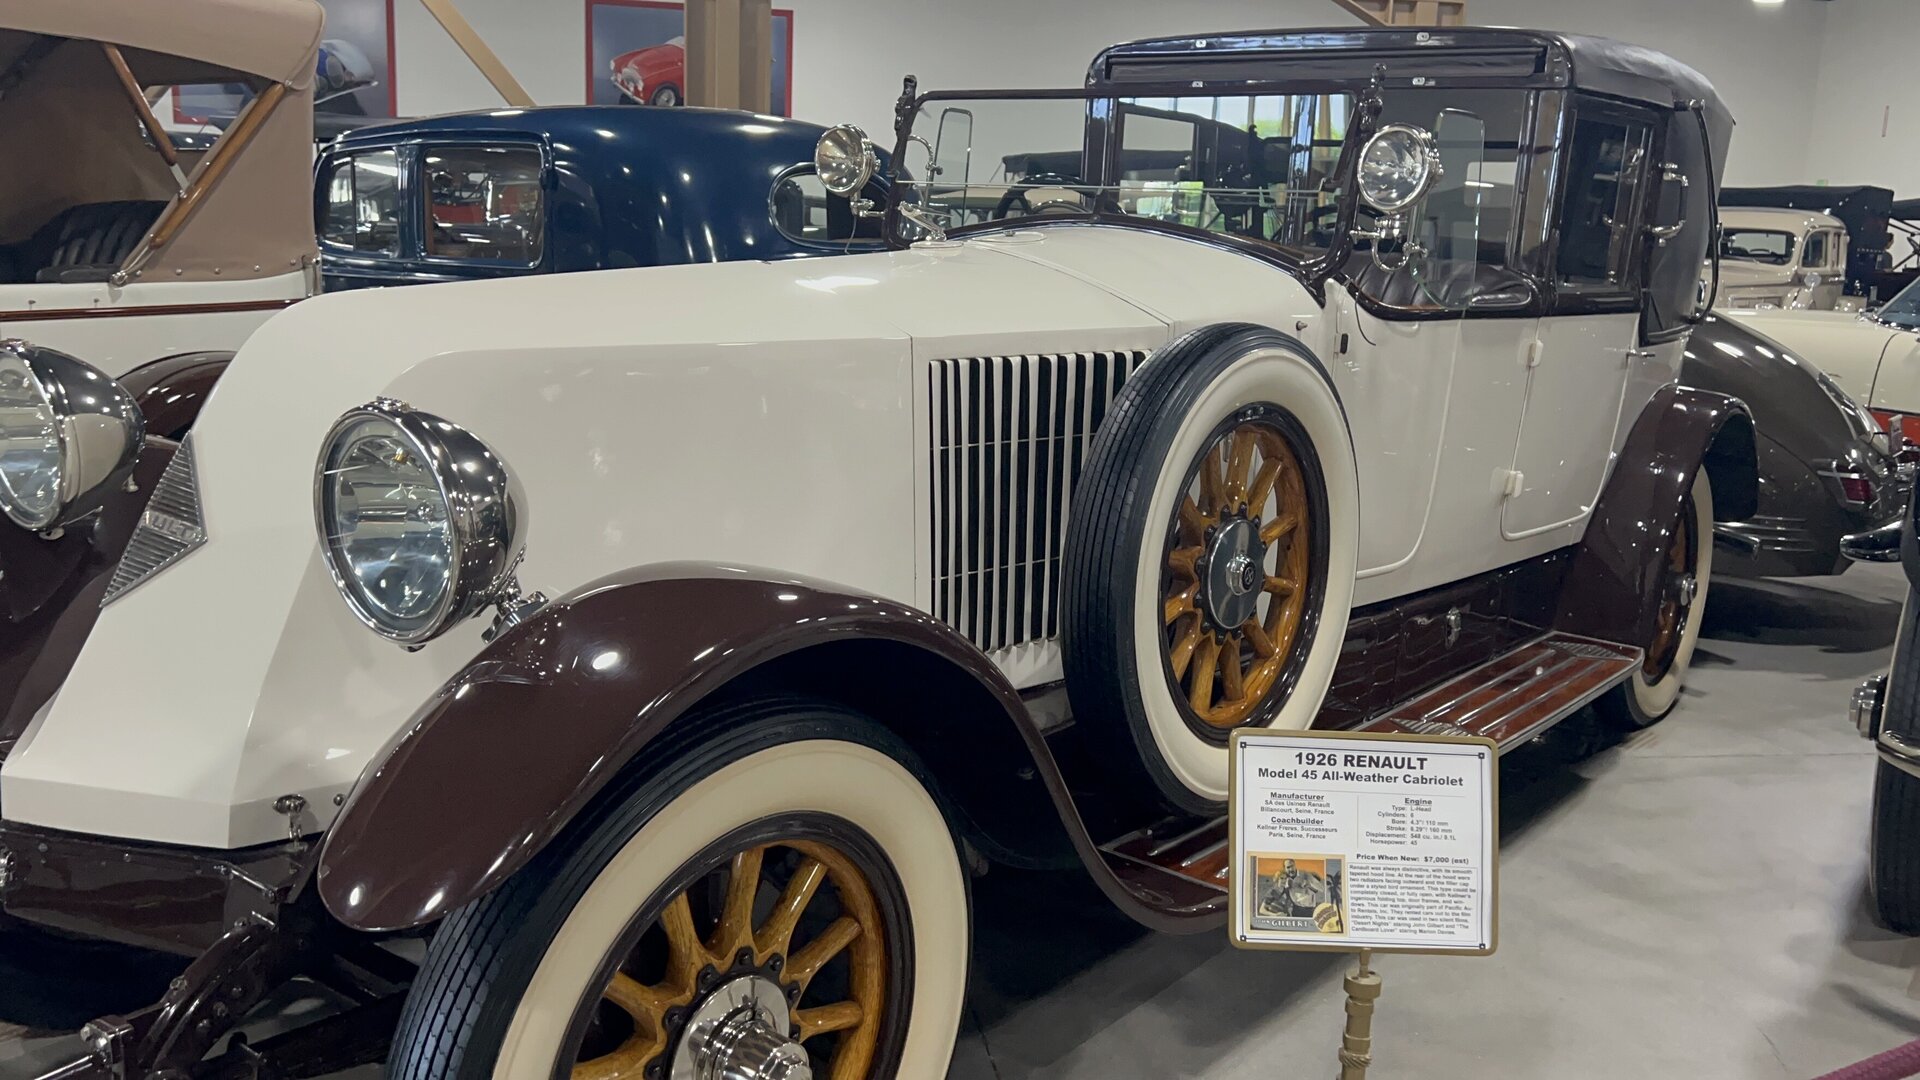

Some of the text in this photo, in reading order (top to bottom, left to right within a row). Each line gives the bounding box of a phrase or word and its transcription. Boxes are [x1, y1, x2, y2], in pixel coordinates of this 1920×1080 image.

[1295, 752, 1428, 770] 1926 RENAULT
[1258, 768, 1463, 786] Model 45 All-Weather Cabriolet
[1270, 792, 1324, 800] Manufacturer
[1405, 798, 1432, 806] Engine
